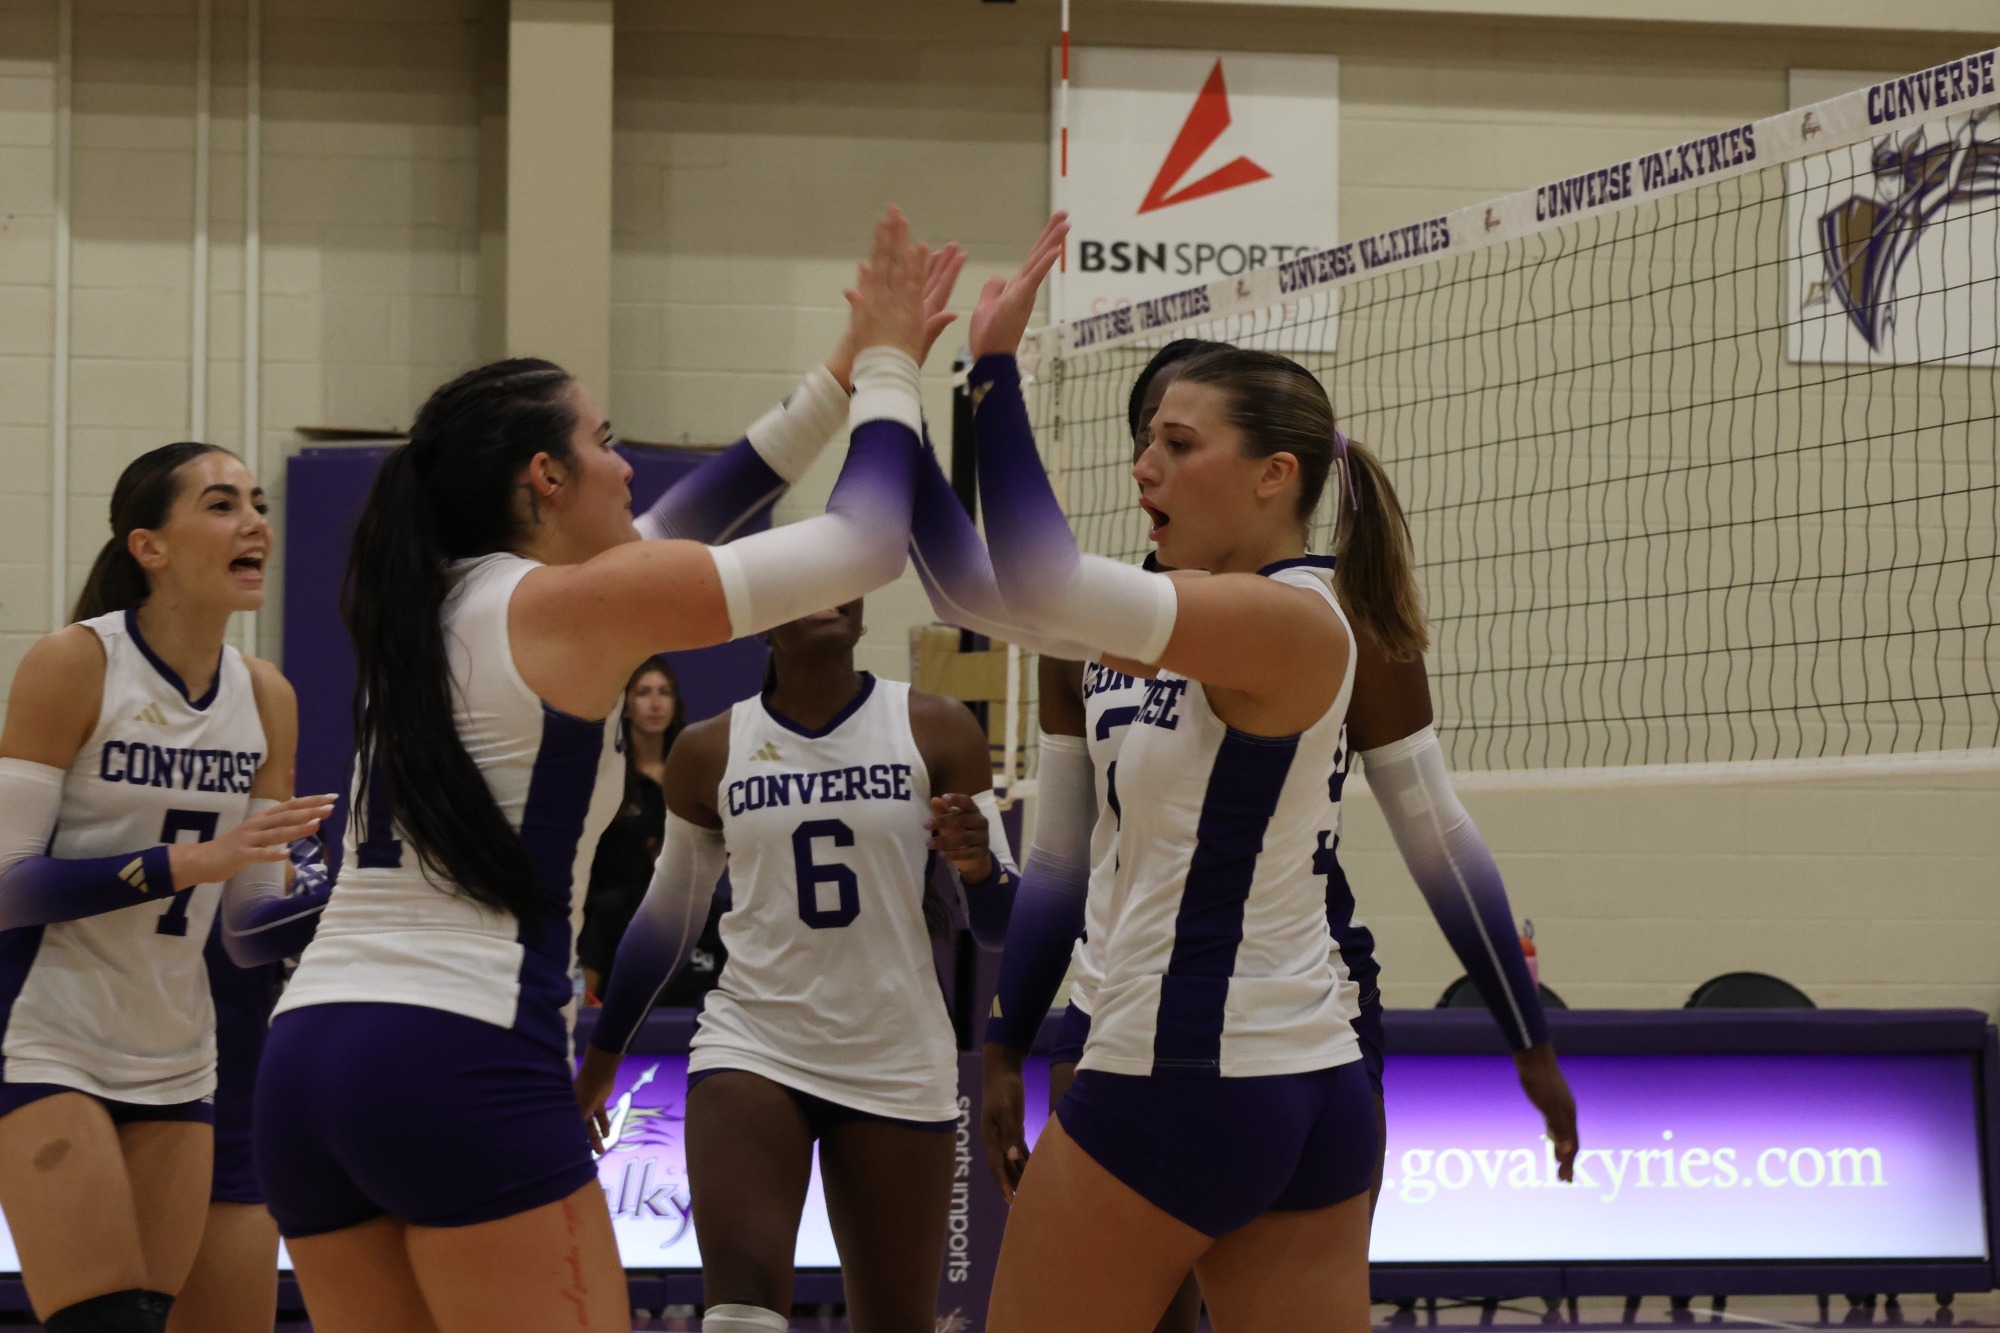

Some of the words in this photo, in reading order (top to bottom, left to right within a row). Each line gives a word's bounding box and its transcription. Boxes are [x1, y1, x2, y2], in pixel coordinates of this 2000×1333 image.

[1868, 51, 1995, 125] CONVERSE
[1535, 161, 1633, 222] CONVERSE
[1639, 123, 1757, 192] VALKYRIES
[1079, 240, 1167, 274] BSN
[1279, 243, 1356, 294] CONVERSE
[1359, 216, 1451, 270] VALKYRIES
[101, 740, 261, 794] CONVERS
[728, 763, 912, 817] CONVERSE
[157, 808, 221, 937] 7
[791, 818, 861, 930] 6
[1384, 1129, 1888, 1204] .govalkyries.com
[947, 1182, 971, 1283] imports
